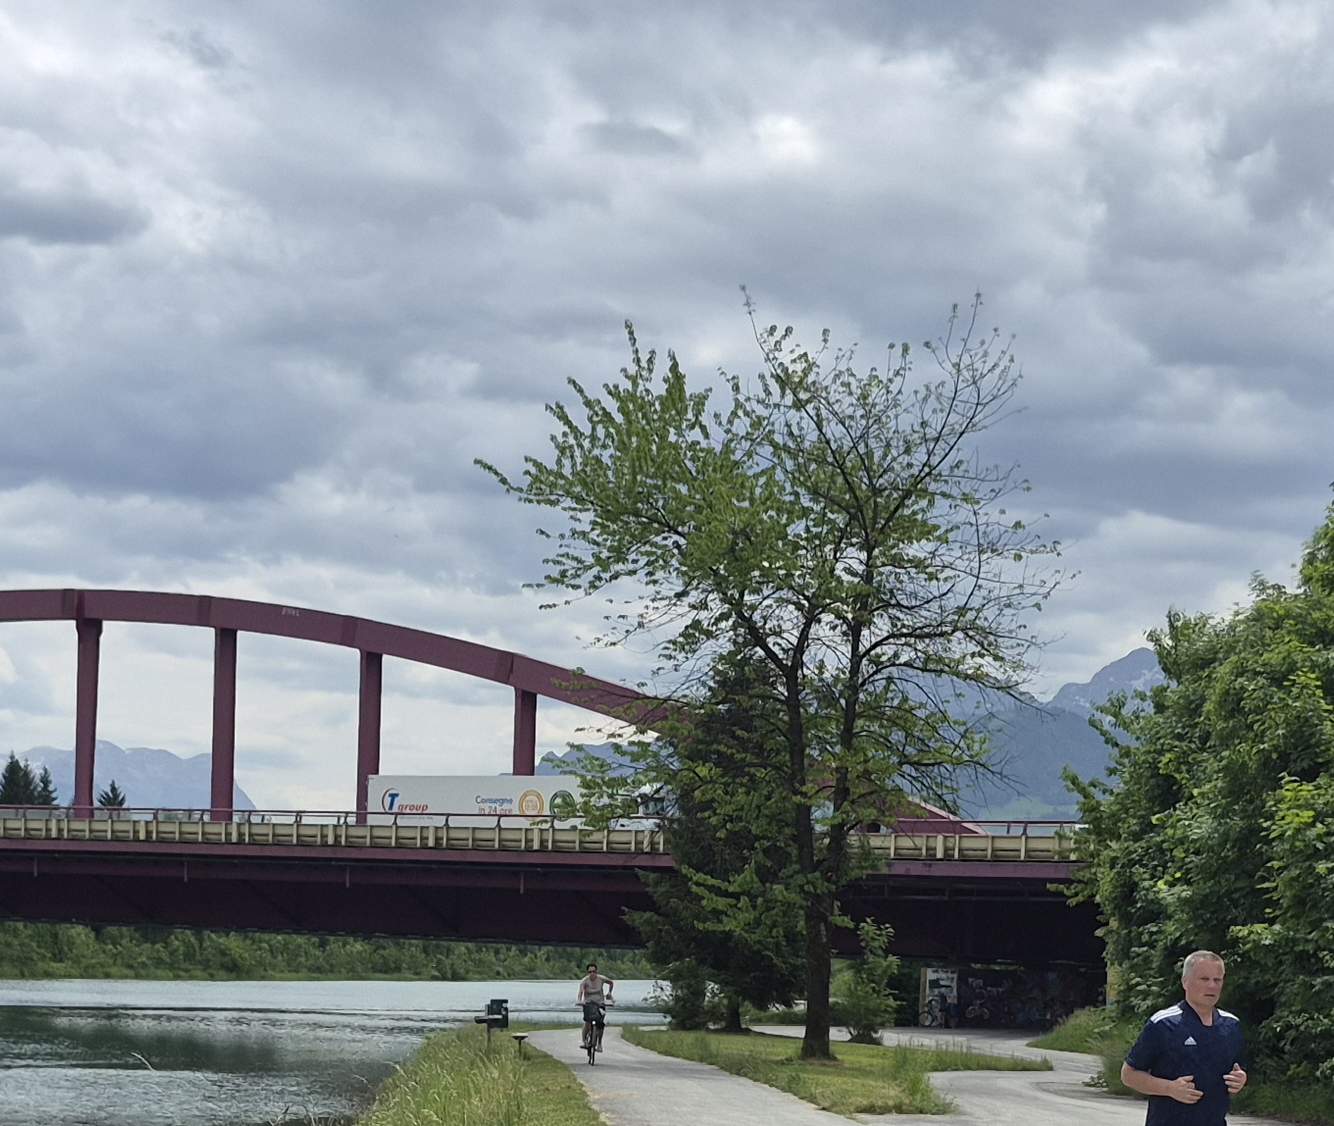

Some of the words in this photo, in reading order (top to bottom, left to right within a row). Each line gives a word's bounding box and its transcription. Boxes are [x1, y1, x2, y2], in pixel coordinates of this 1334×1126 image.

[475, 795, 514, 806] Consegne
[398, 803, 429, 813] group
[487, 805, 498, 814] 24
